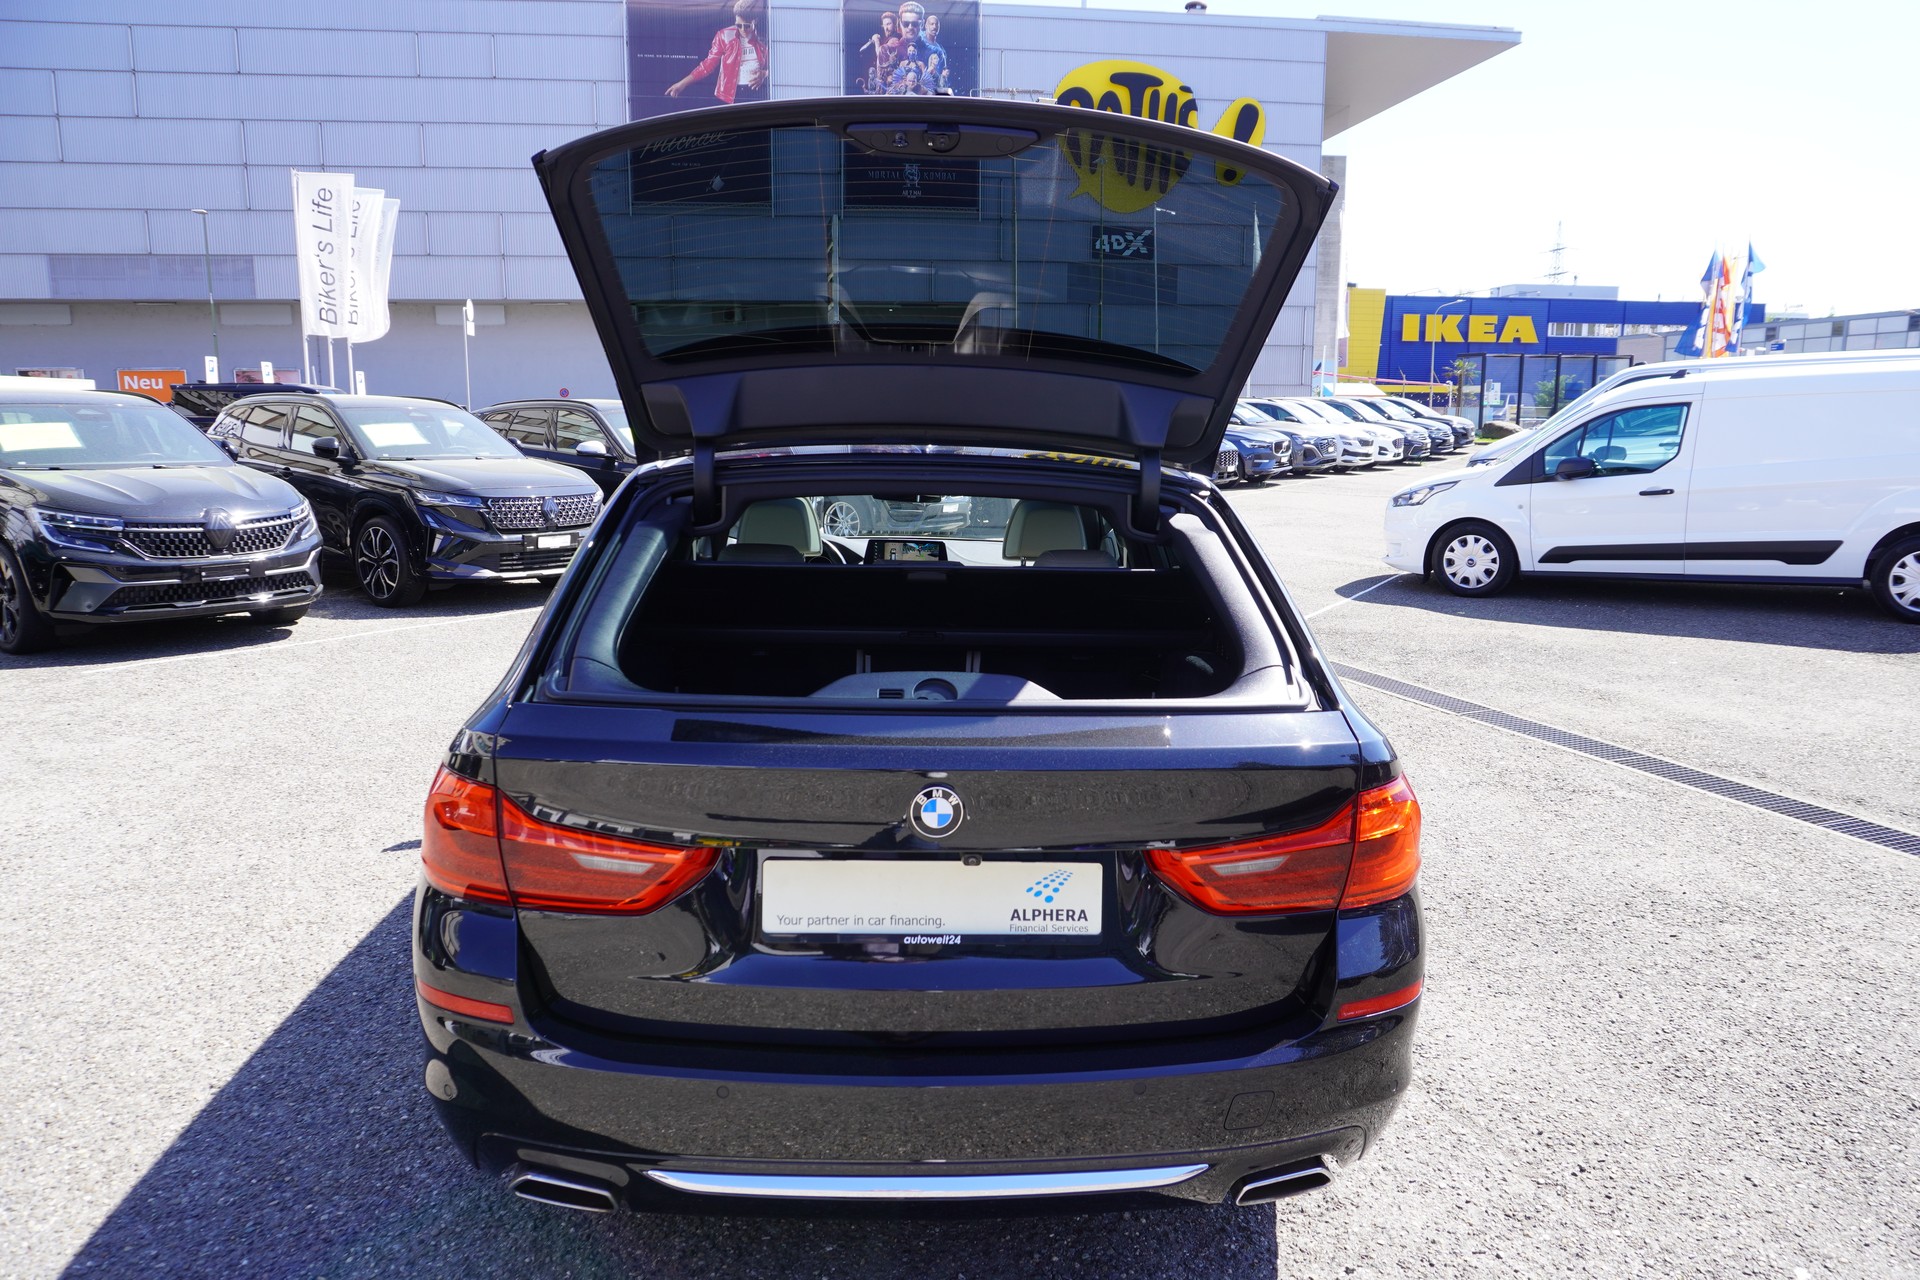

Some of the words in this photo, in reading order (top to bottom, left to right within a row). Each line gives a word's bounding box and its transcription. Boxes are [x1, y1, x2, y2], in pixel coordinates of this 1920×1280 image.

[868, 169, 901, 180] MORTAL
[923, 171, 957, 182] KOMBAT
[312, 187, 333, 233] Life
[1095, 229, 1152, 256] 4DX
[314, 240, 338, 326] Biker's
[1401, 313, 1539, 344] IKEA
[123, 375, 164, 390] Neu
[916, 788, 959, 806] BMW
[776, 914, 803, 926] Your
[807, 914, 851, 928] partner
[854, 914, 864, 926] in
[868, 916, 886, 926] car
[889, 914, 946, 928] financing.
[1010, 908, 1088, 922] ALPHERA
[1009, 923, 1048, 932] Financial
[1051, 923, 1089, 932] Services
[903, 934, 961, 945] autowelt24
